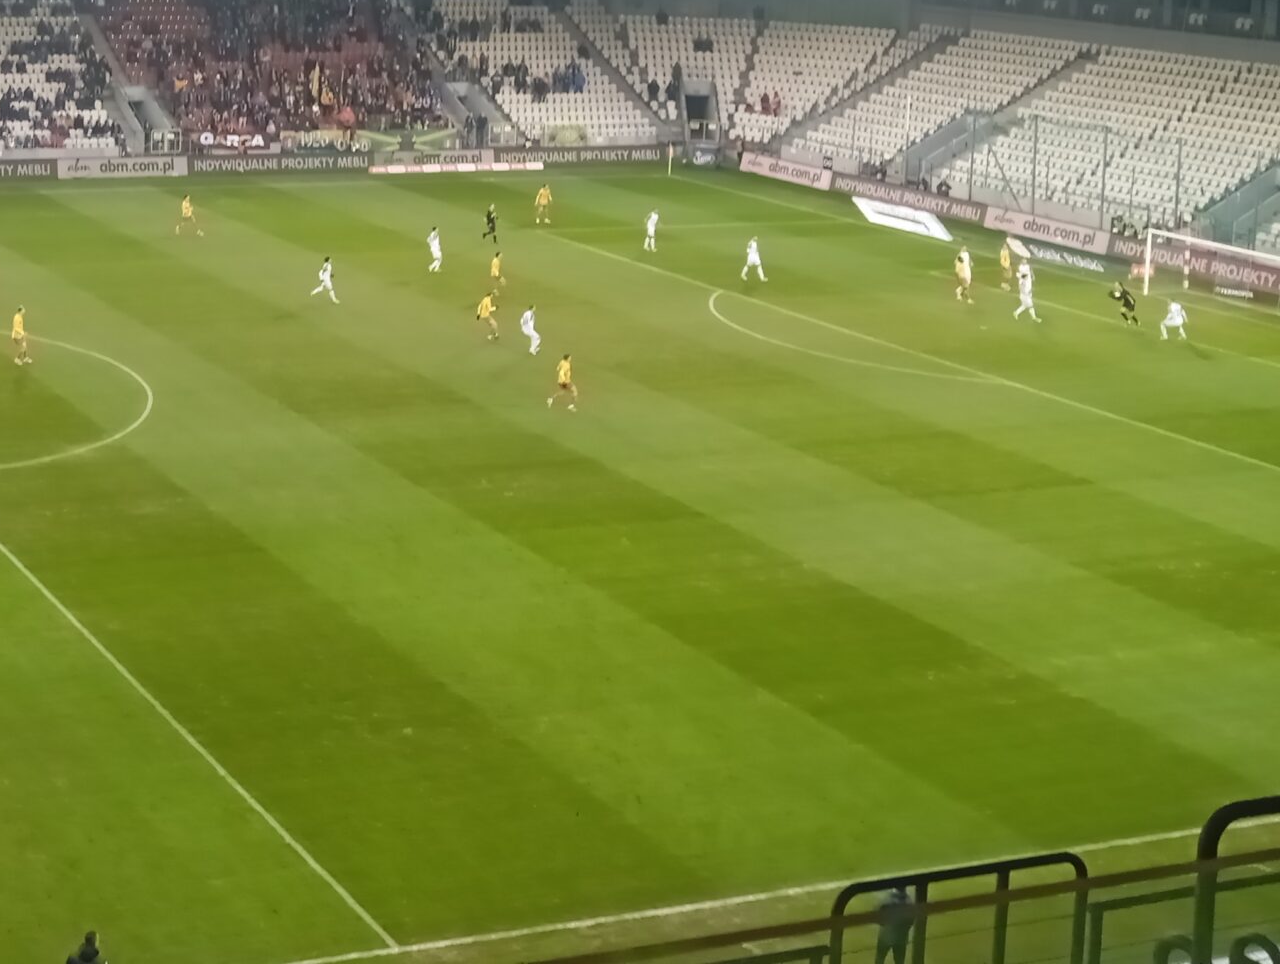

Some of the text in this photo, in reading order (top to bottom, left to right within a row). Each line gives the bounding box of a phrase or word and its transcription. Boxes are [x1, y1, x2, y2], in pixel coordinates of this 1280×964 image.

[100, 158, 175, 174] abm.com.pl
[281, 157, 334, 170] PROJEKTY
[337, 156, 369, 169] MEBLI
[500, 149, 660, 163] INDYWIDUALNE PROJEKTY MEBLI
[17, 163, 51, 176] MEBLI
[769, 160, 823, 187] abm.com.pl
[835, 177, 981, 221] INDYWIDUALNE PROJEKTY MEBLI
[1023, 218, 1096, 246] abm.com.pl
[1211, 259, 1277, 288] PROJEKTY
